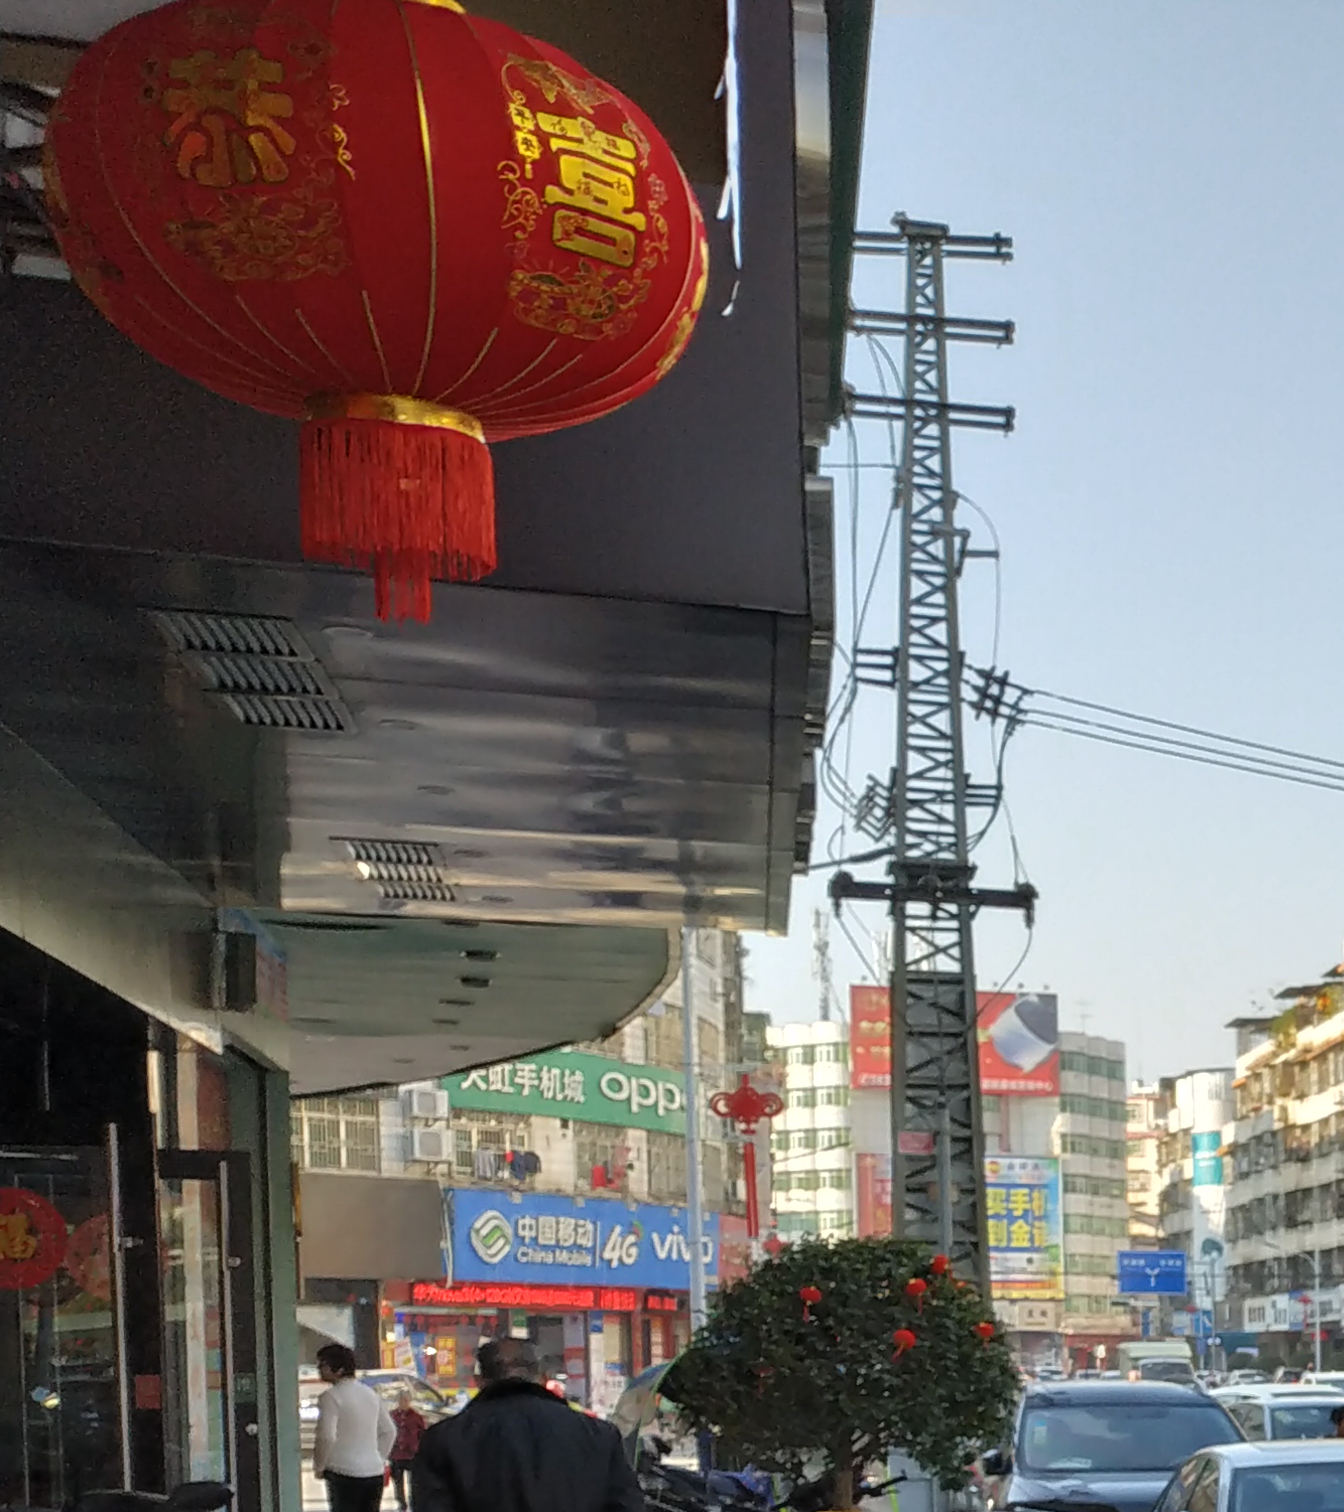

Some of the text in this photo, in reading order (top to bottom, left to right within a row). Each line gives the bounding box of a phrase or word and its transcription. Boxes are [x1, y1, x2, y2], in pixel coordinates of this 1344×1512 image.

[600, 1071, 690, 1117] opp
[516, 1215, 594, 1247] 中国移动
[603, 1224, 639, 1268] 4G
[517, 1247, 592, 1267] China Mobile
